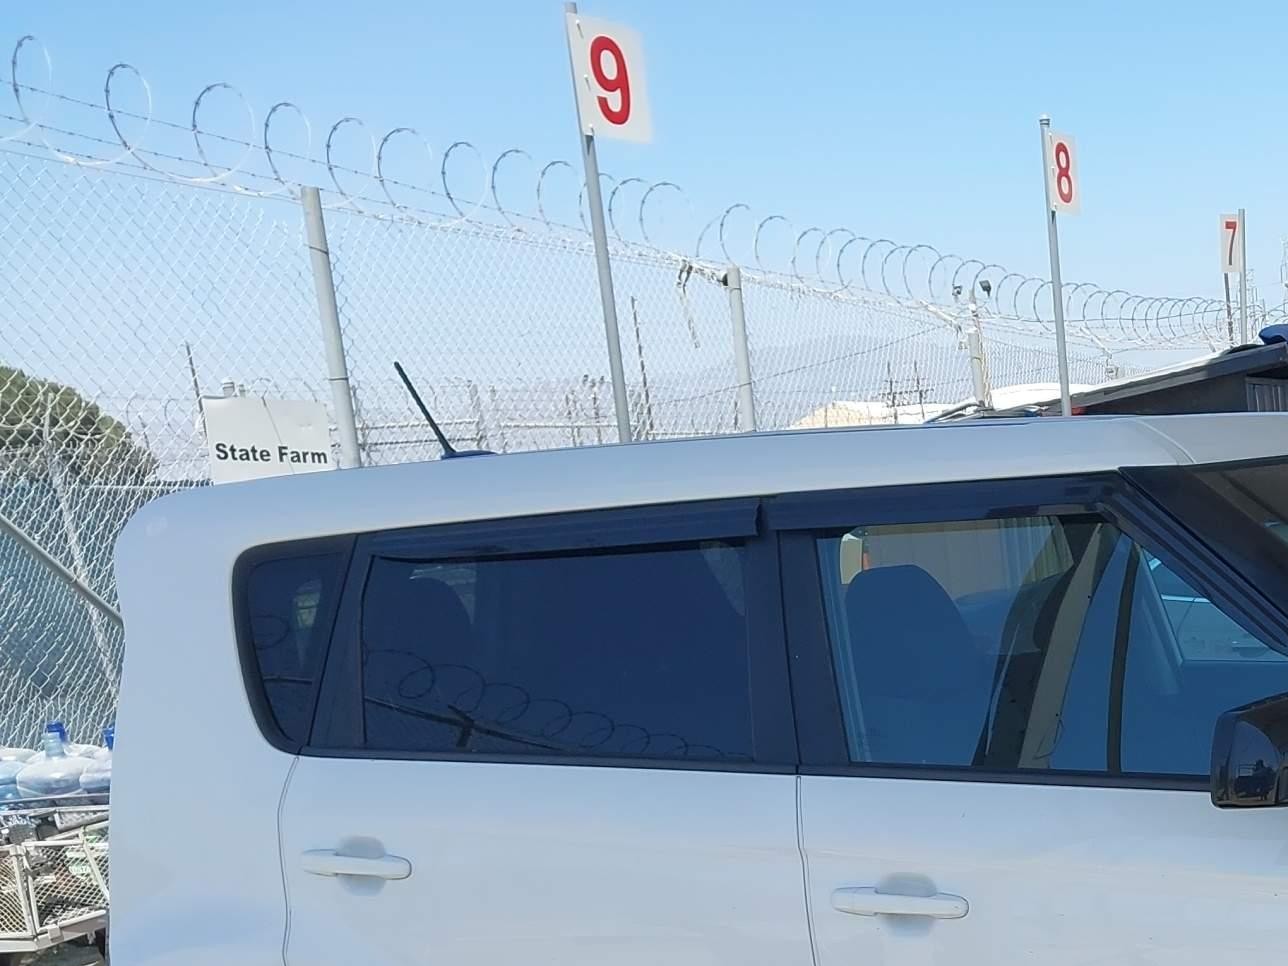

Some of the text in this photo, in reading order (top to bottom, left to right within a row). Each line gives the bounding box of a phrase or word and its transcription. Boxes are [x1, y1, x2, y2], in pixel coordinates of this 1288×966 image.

[591, 36, 631, 125] 9
[1055, 142, 1073, 204] 8
[1225, 221, 1238, 265] 7
[215, 443, 328, 464] State Farm
